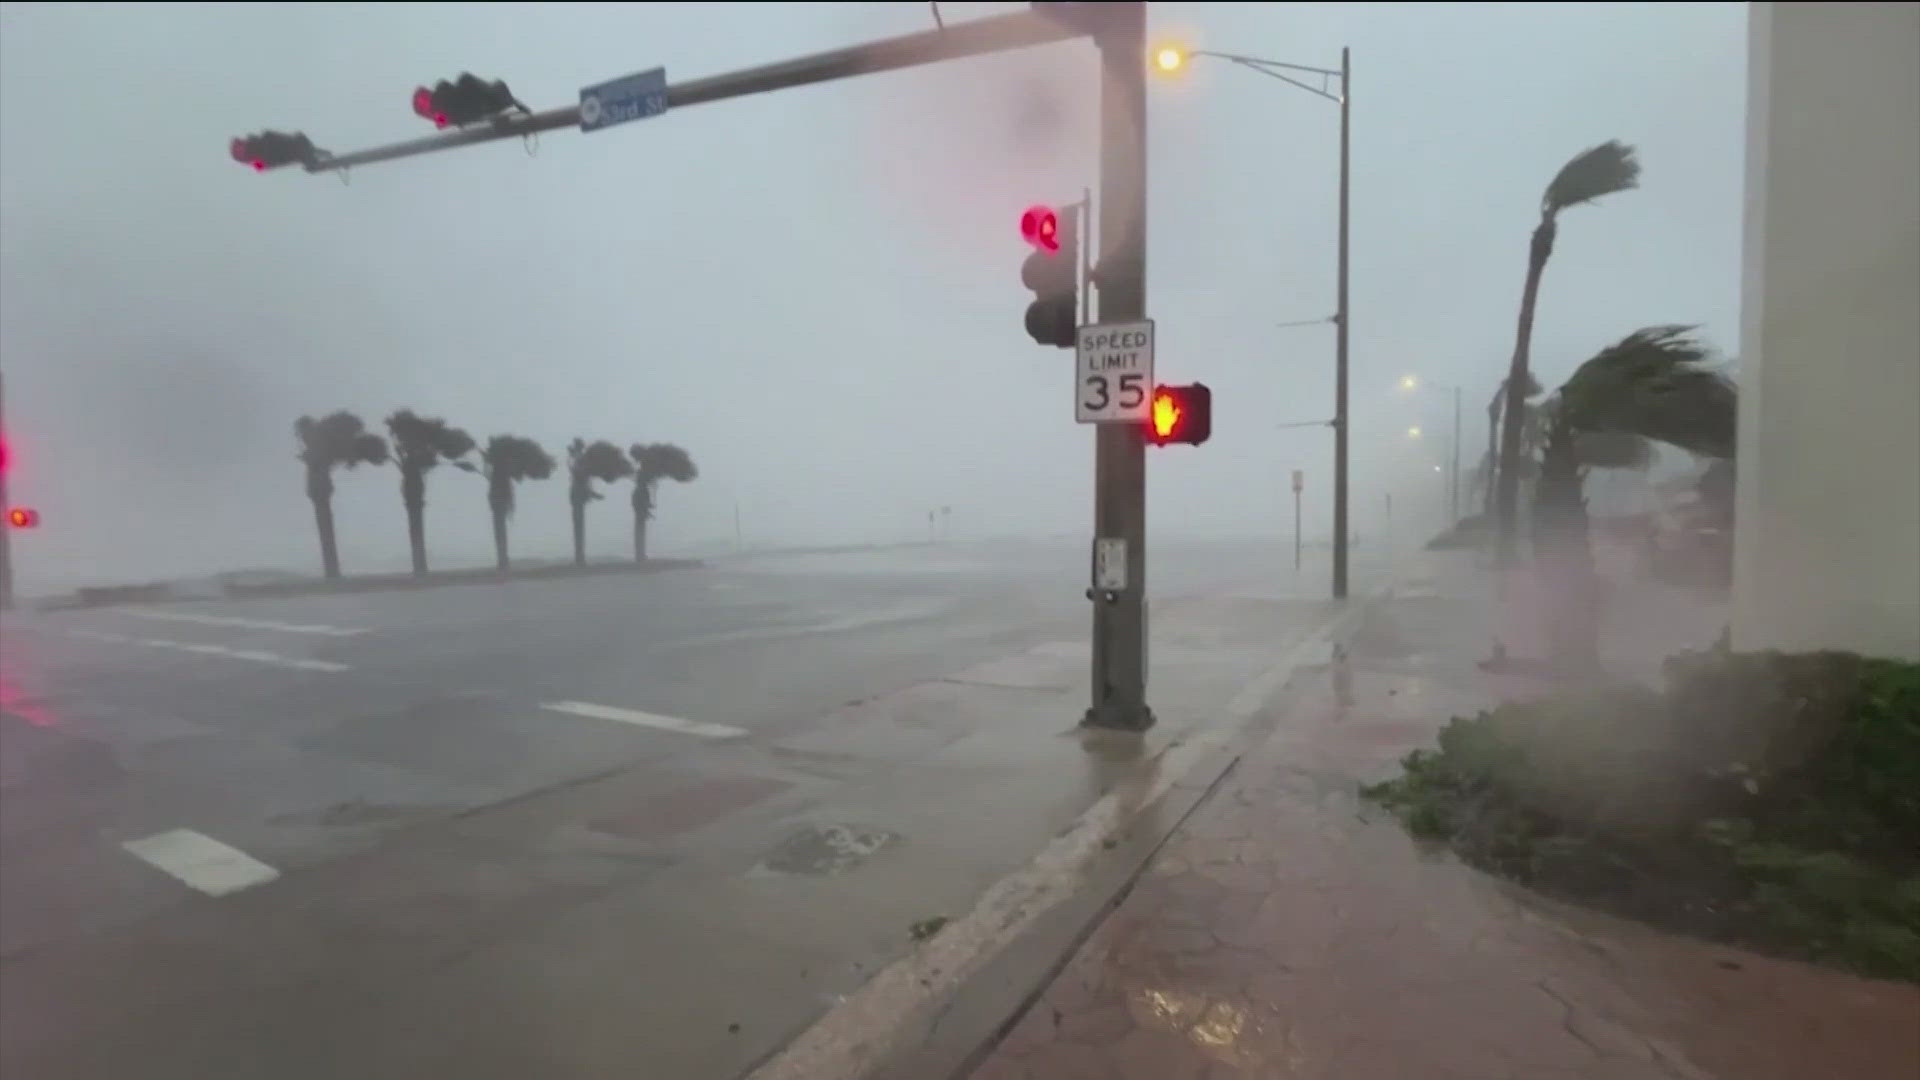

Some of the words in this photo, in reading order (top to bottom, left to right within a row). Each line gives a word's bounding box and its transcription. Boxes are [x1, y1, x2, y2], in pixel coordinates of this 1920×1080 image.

[1083, 331, 1147, 351] SPEED
[1089, 353, 1138, 370] LIMIT
[1084, 374, 1145, 412] 35
